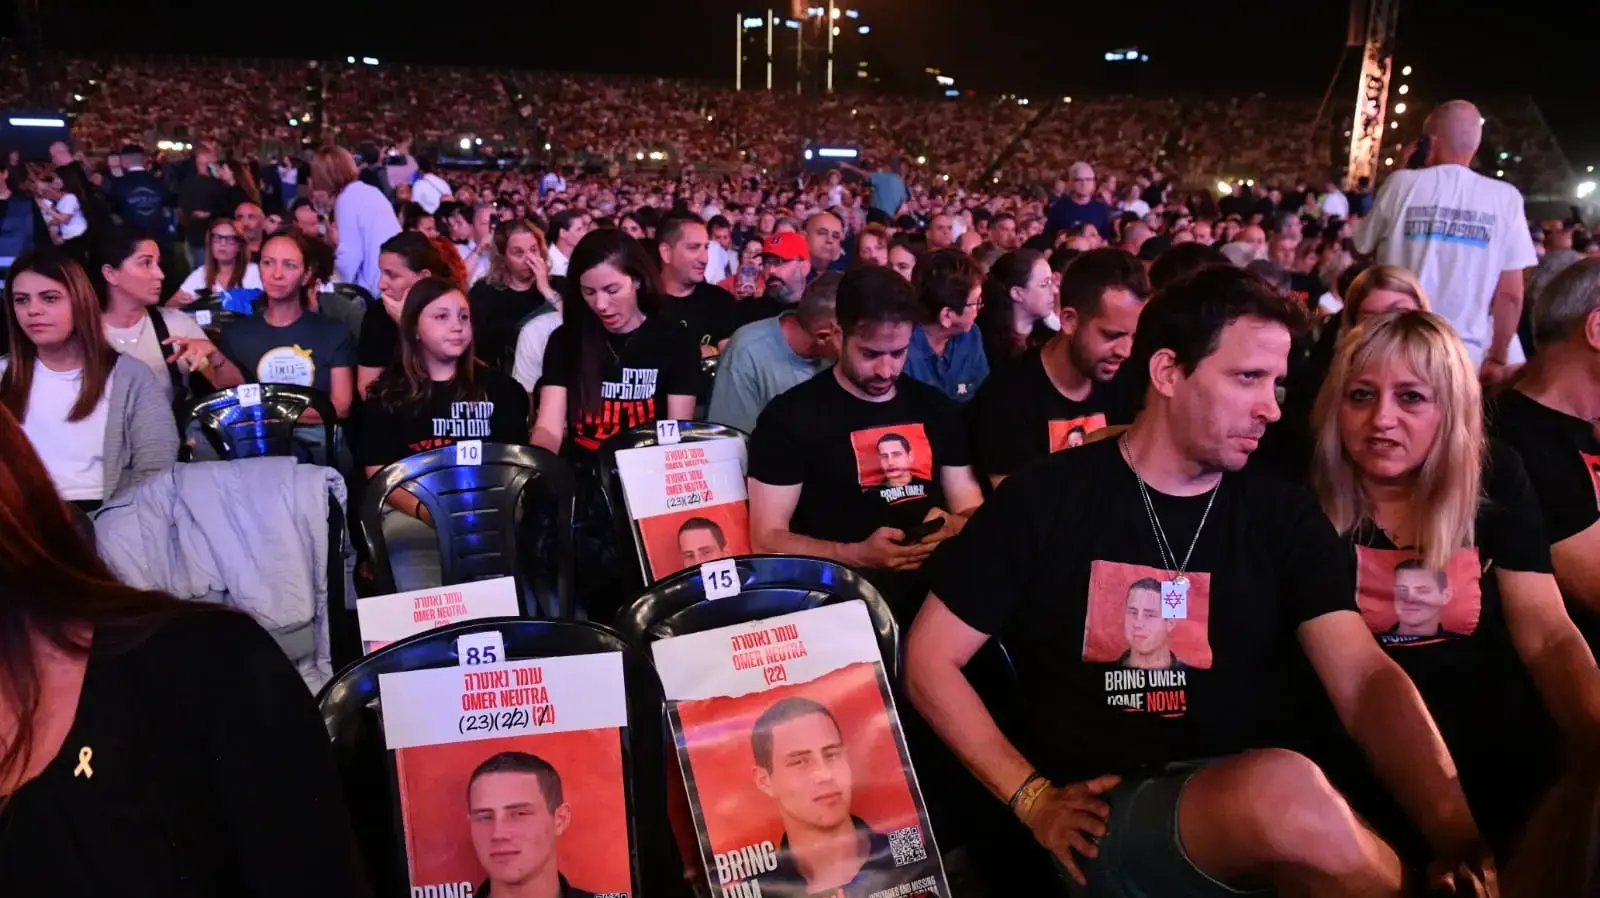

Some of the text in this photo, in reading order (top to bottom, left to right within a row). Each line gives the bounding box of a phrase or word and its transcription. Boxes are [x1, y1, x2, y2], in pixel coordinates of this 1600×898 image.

[244, 386, 258, 398] 27
[658, 423, 675, 438] 17
[460, 446, 478, 460] 10
[708, 569, 733, 590] 15
[413, 608, 436, 624] OMER
[436, 603, 468, 619] NEUTRA
[731, 623, 798, 652] עומר נאוטרה
[466, 645, 497, 665] 85
[732, 641, 808, 671] OMER NEUTRA
[464, 666, 543, 691] עומר נאוטרה
[763, 664, 787, 686] (22)
[1105, 669, 1145, 692] BRING
[462, 686, 549, 712] OMER NEUTRA
[1146, 690, 1187, 713] NOW!
[714, 840, 778, 884] BRING
